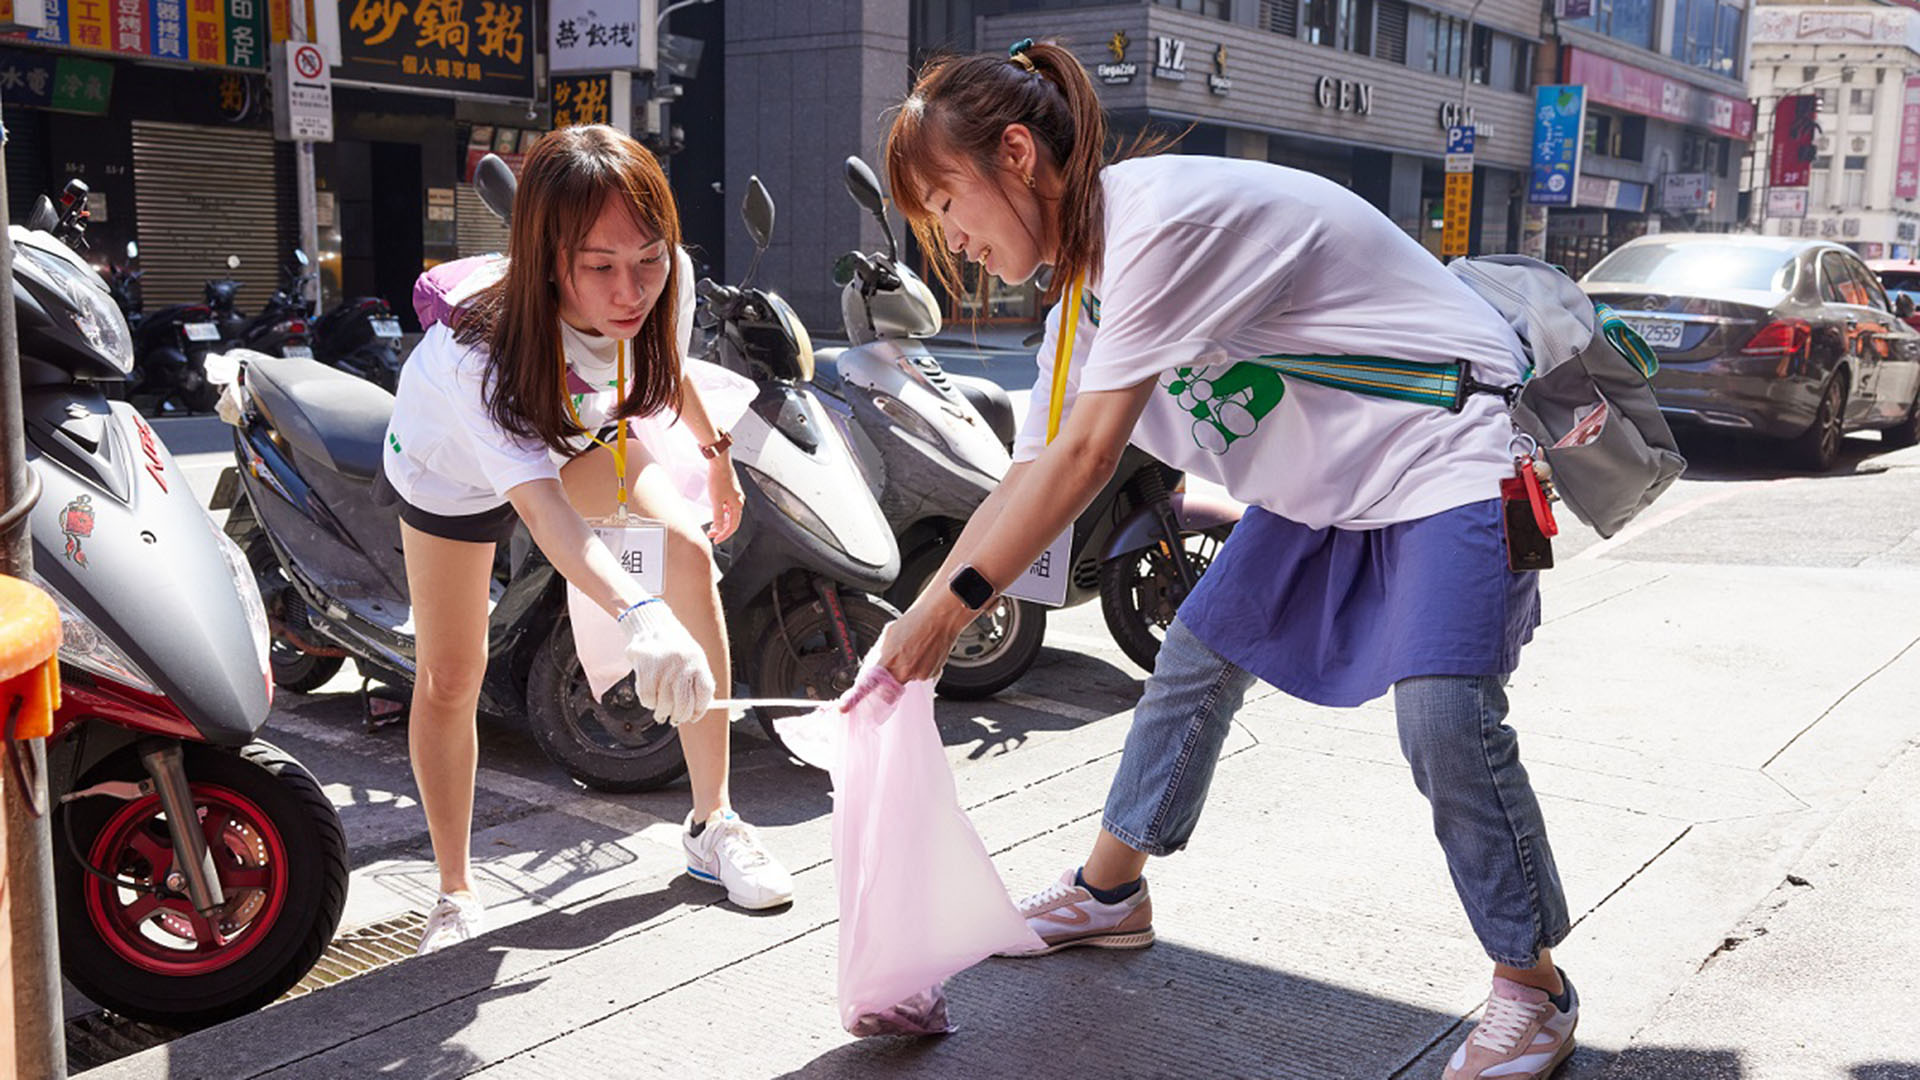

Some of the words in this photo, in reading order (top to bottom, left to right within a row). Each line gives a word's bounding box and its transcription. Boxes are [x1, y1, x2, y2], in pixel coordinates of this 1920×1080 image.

[1159, 37, 1185, 70] EZ
[1318, 75, 1373, 115] GEM
[1449, 128, 1462, 147] P
[621, 550, 643, 574] 組
